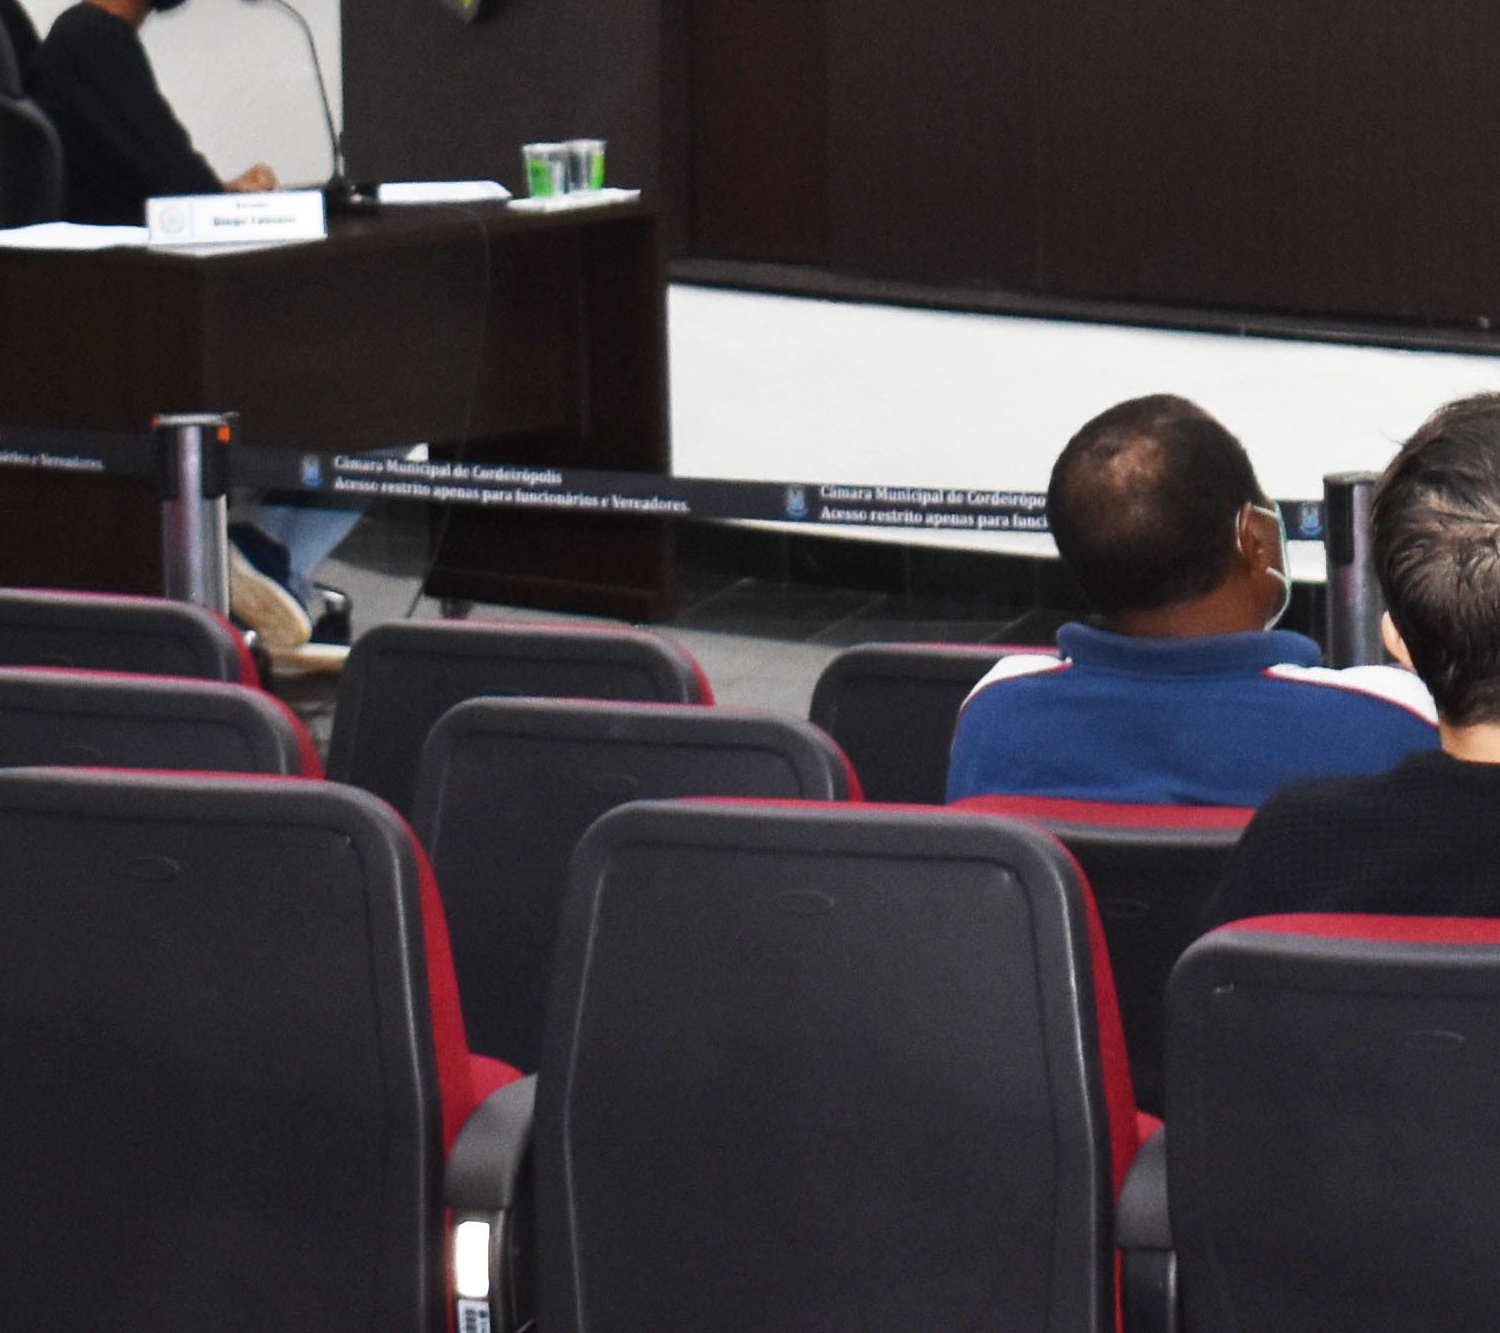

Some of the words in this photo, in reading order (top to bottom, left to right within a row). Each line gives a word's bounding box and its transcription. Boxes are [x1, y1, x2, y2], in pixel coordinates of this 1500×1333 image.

[386, 459, 451, 479] Municipal
[453, 463, 470, 477] de
[334, 476, 377, 491] Acesso
[381, 479, 432, 495] restrito
[433, 484, 479, 500] apenas
[481, 487, 513, 502] para
[516, 488, 599, 506] funcionários
[875, 486, 944, 505] Municipal
[947, 490, 964, 504] de
[967, 490, 1046, 509] Cordeirópo
[820, 505, 867, 521] Acesso
[870, 508, 923, 524] restrito
[925, 513, 974, 528] apenas
[977, 514, 1009, 529] para
